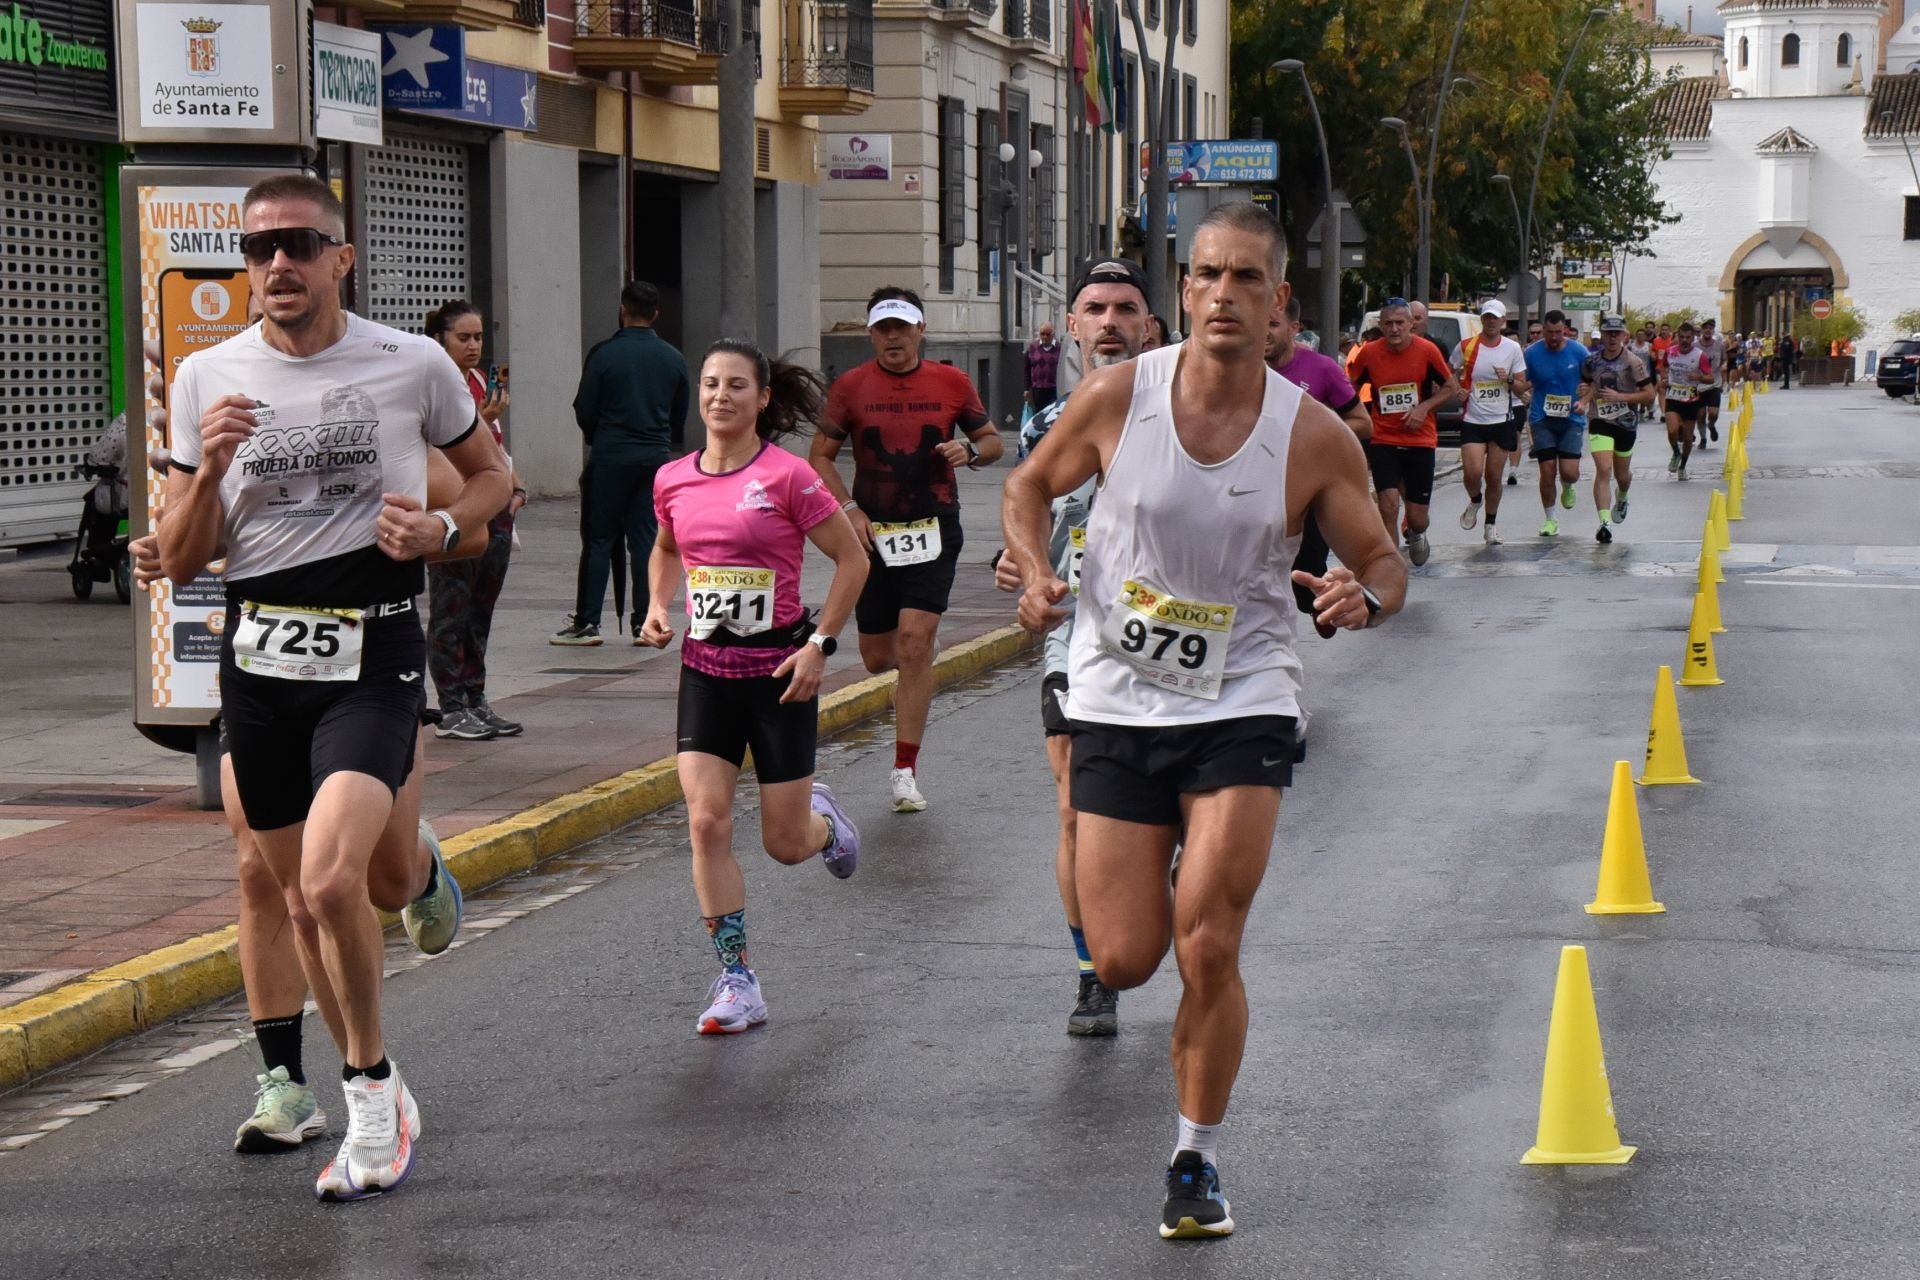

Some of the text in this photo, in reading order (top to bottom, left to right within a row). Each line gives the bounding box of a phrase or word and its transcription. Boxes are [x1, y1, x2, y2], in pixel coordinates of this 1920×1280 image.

[46, 32, 107, 71] Zapaterías
[319, 50, 377, 107] TECNOCASA
[155, 82, 259, 99] Ayuntamiento
[388, 88, 442, 98] D-Sastre
[153, 100, 259, 116] de Santa Fe
[1238, 169, 1254, 179] 472
[150, 202, 242, 229] WHATSA
[170, 232, 225, 253] SANTA
[184, 335, 195, 343] DE
[1386, 393, 1413, 406] 885
[1480, 388, 1501, 399] 290
[1545, 401, 1570, 412] 3073
[242, 455, 300, 477] PRUEBA
[304, 453, 325, 469] DE
[327, 450, 378, 468] FONDO
[885, 533, 928, 554] 131
[697, 571, 708, 583] 38
[693, 592, 765, 621] 3211
[1156, 604, 1209, 624] ONDO
[255, 617, 340, 657] 725
[1120, 618, 1208, 669] 979
